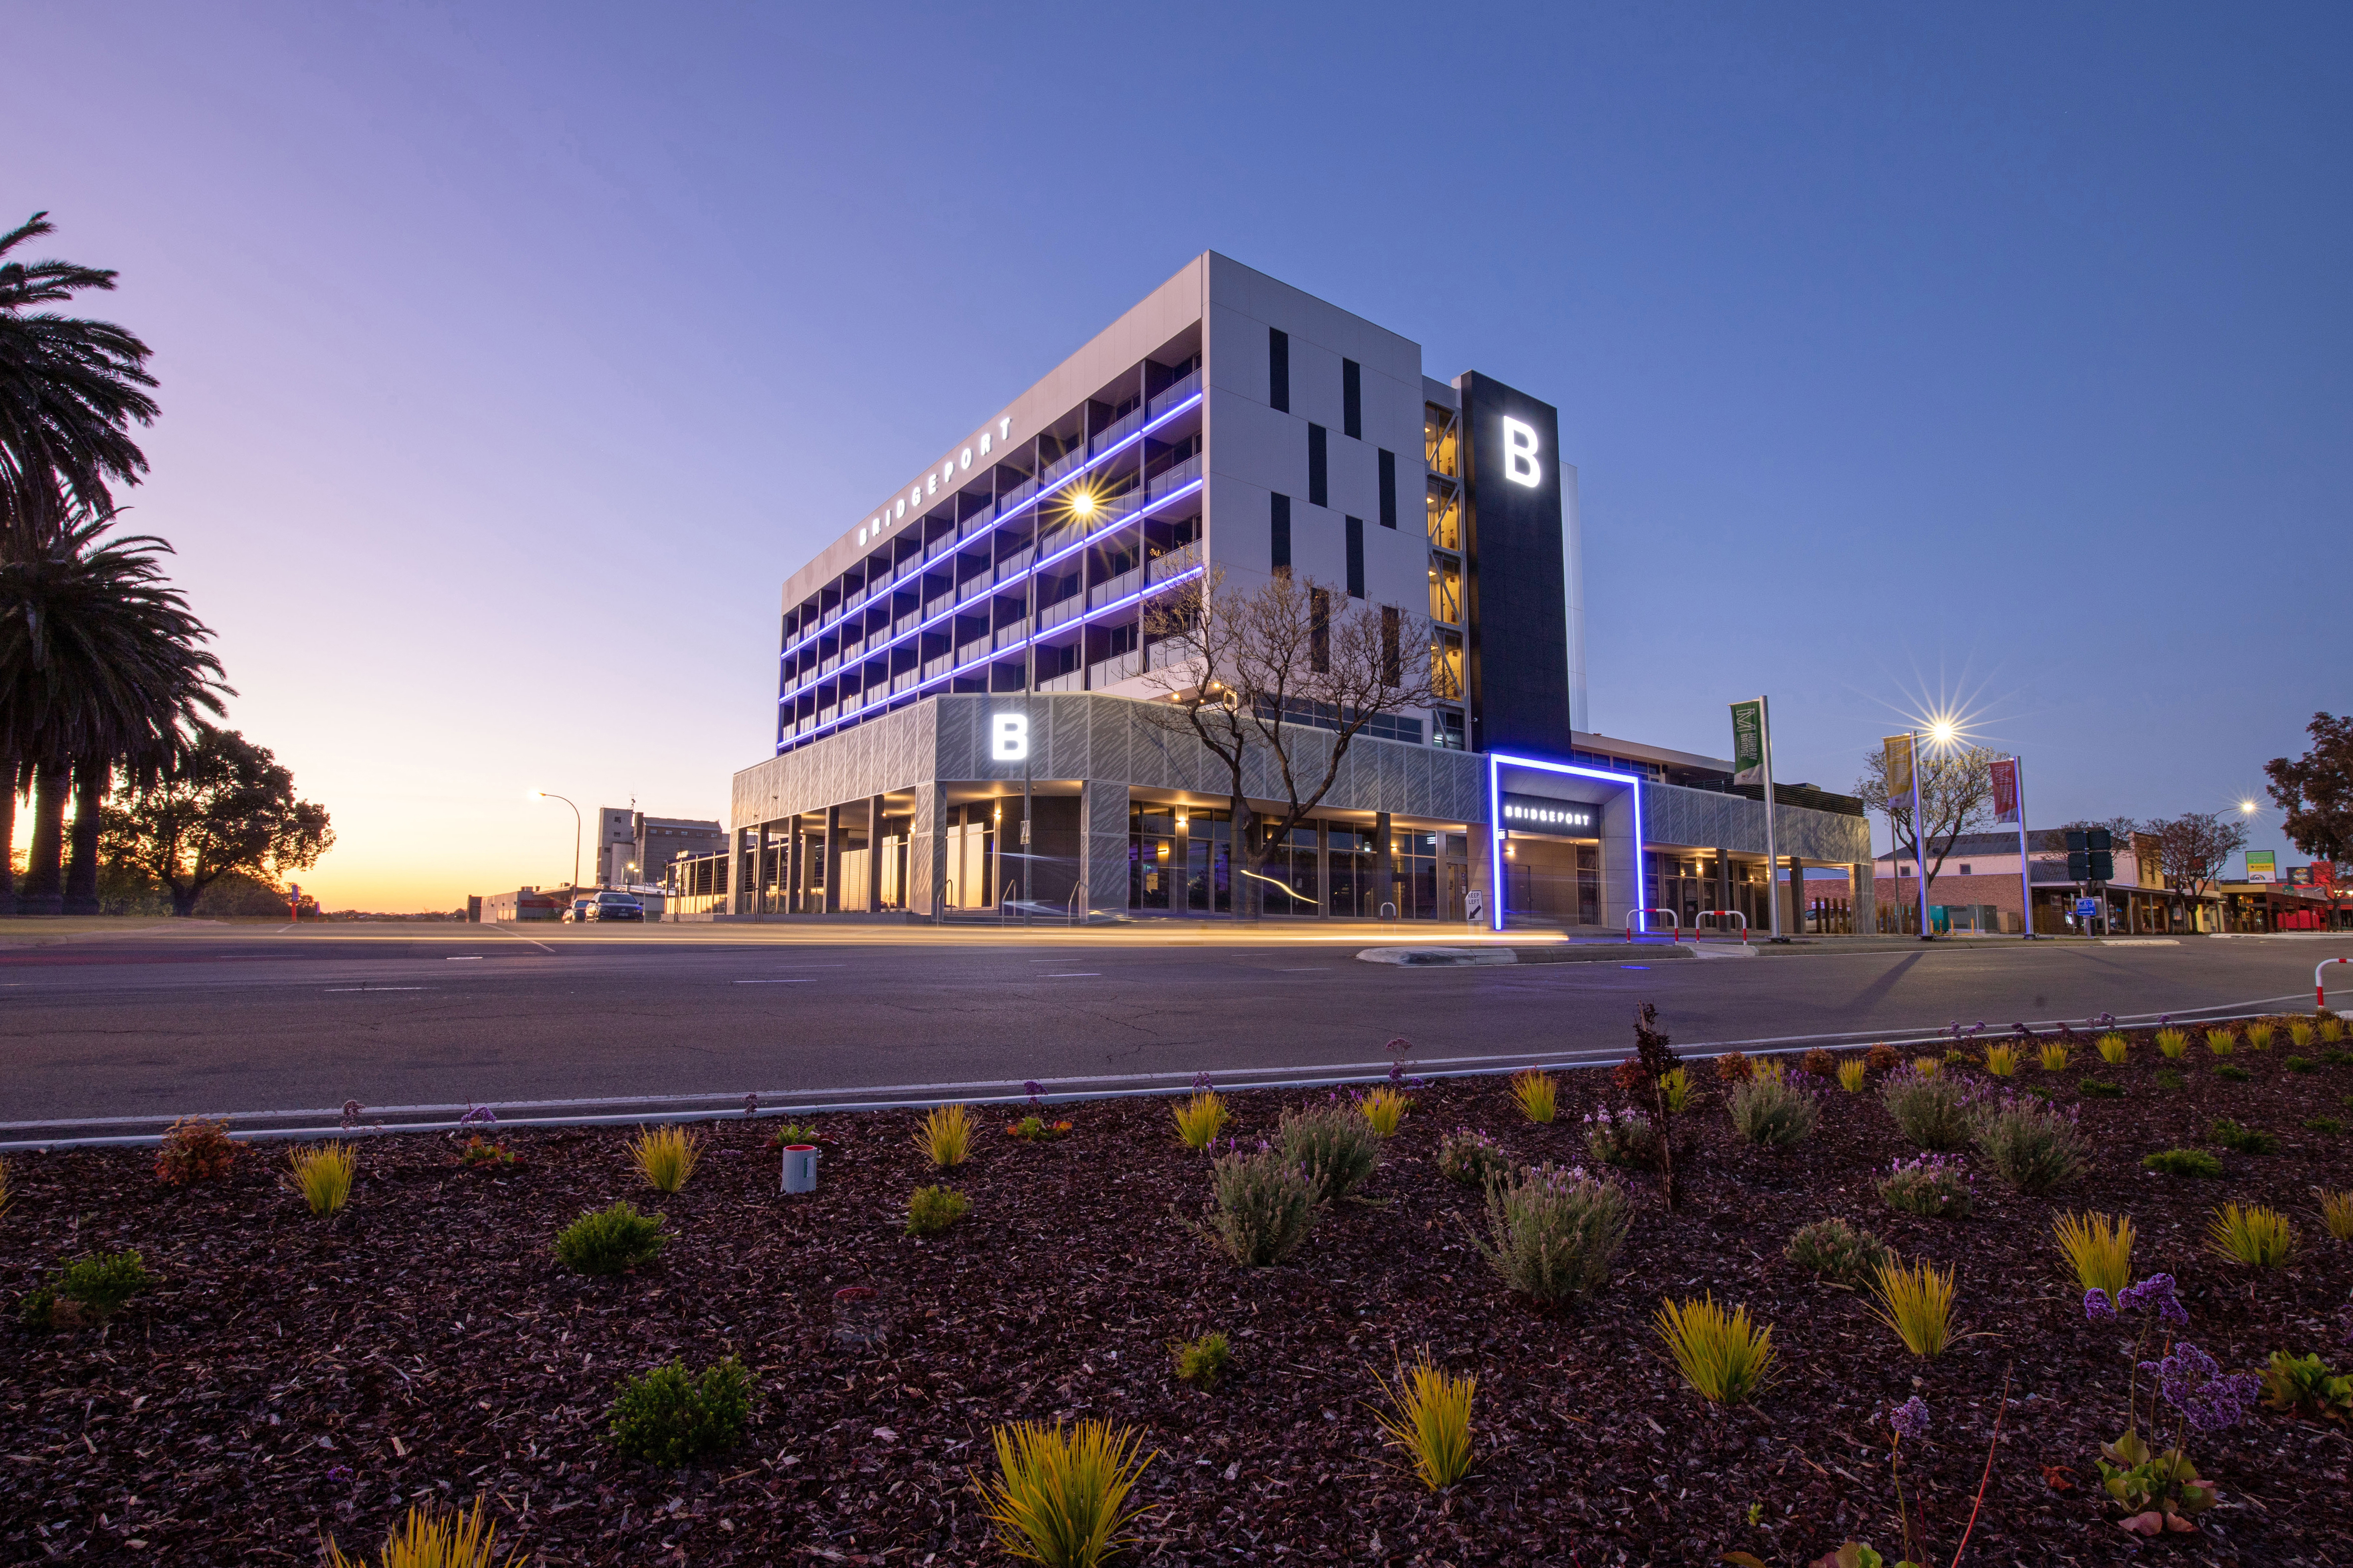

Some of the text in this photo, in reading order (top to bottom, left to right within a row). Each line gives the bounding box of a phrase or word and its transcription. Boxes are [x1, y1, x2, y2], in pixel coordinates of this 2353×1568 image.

[1504, 415, 1541, 488] B
[859, 417, 1011, 546] BRIDGEPORT
[993, 714, 1027, 759] B
[1748, 733, 1757, 760] MURRAY
[1505, 806, 1589, 825] BRIDGEPORT
